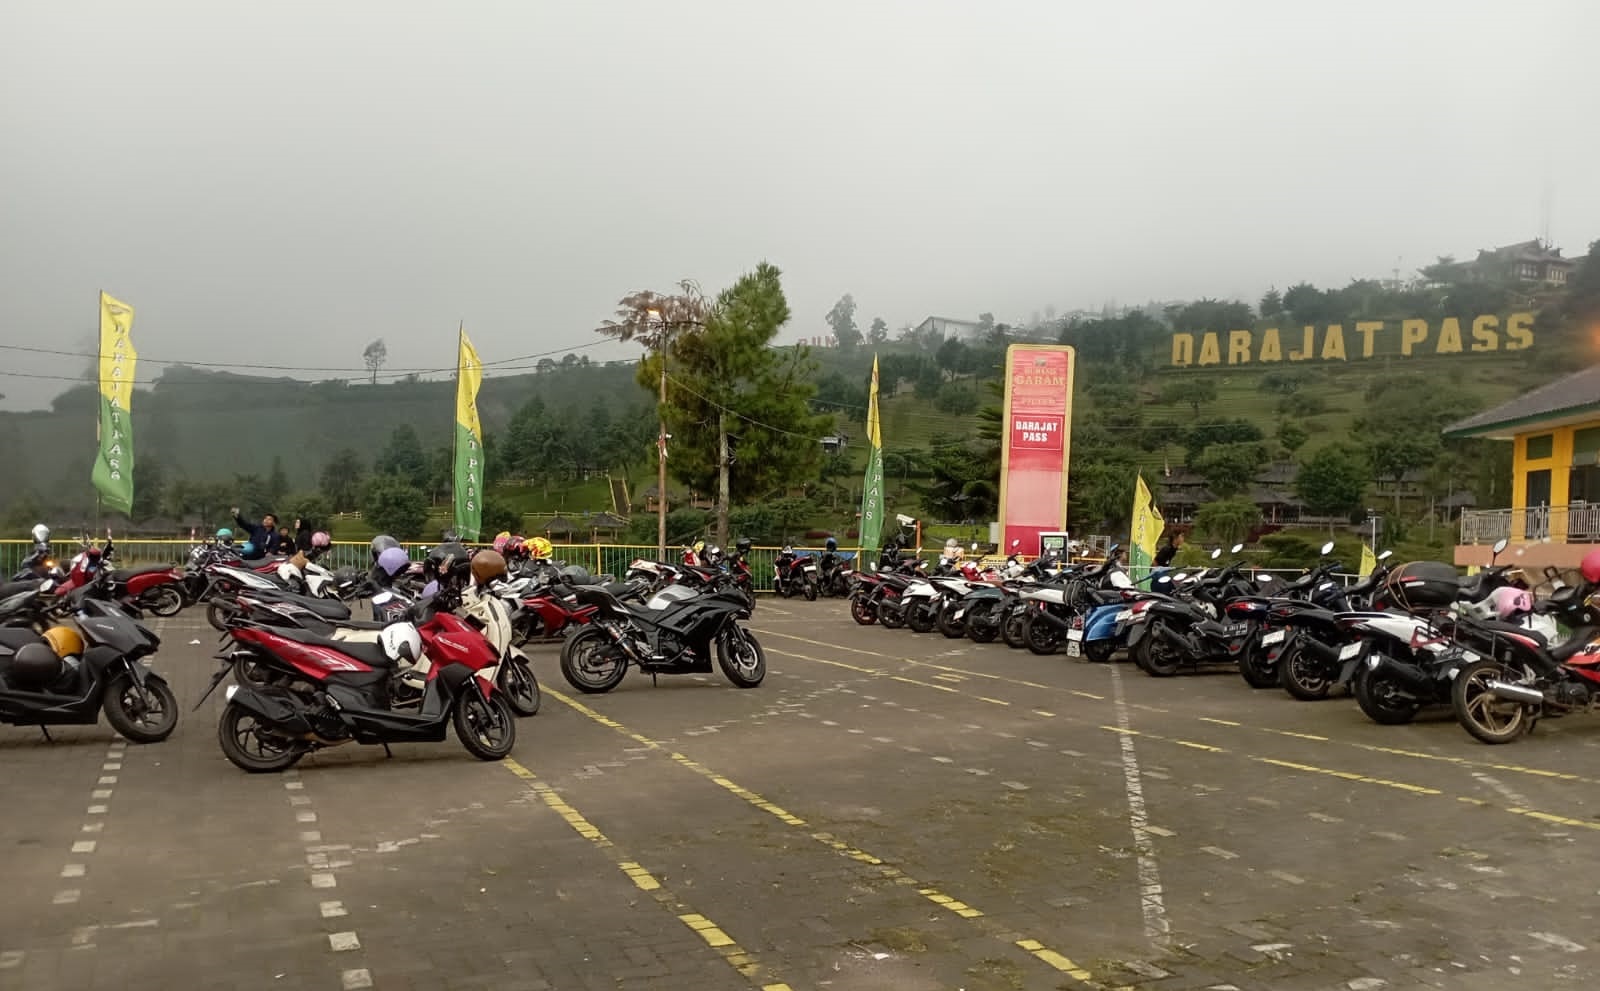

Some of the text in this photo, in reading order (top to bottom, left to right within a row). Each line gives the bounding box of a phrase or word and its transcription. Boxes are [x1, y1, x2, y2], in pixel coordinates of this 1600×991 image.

[1171, 313, 1535, 366] DARAJAT PASS
[1016, 421, 1058, 432] DARAJAT
[1023, 432, 1048, 442] PASS
[866, 474, 881, 520] PASS
